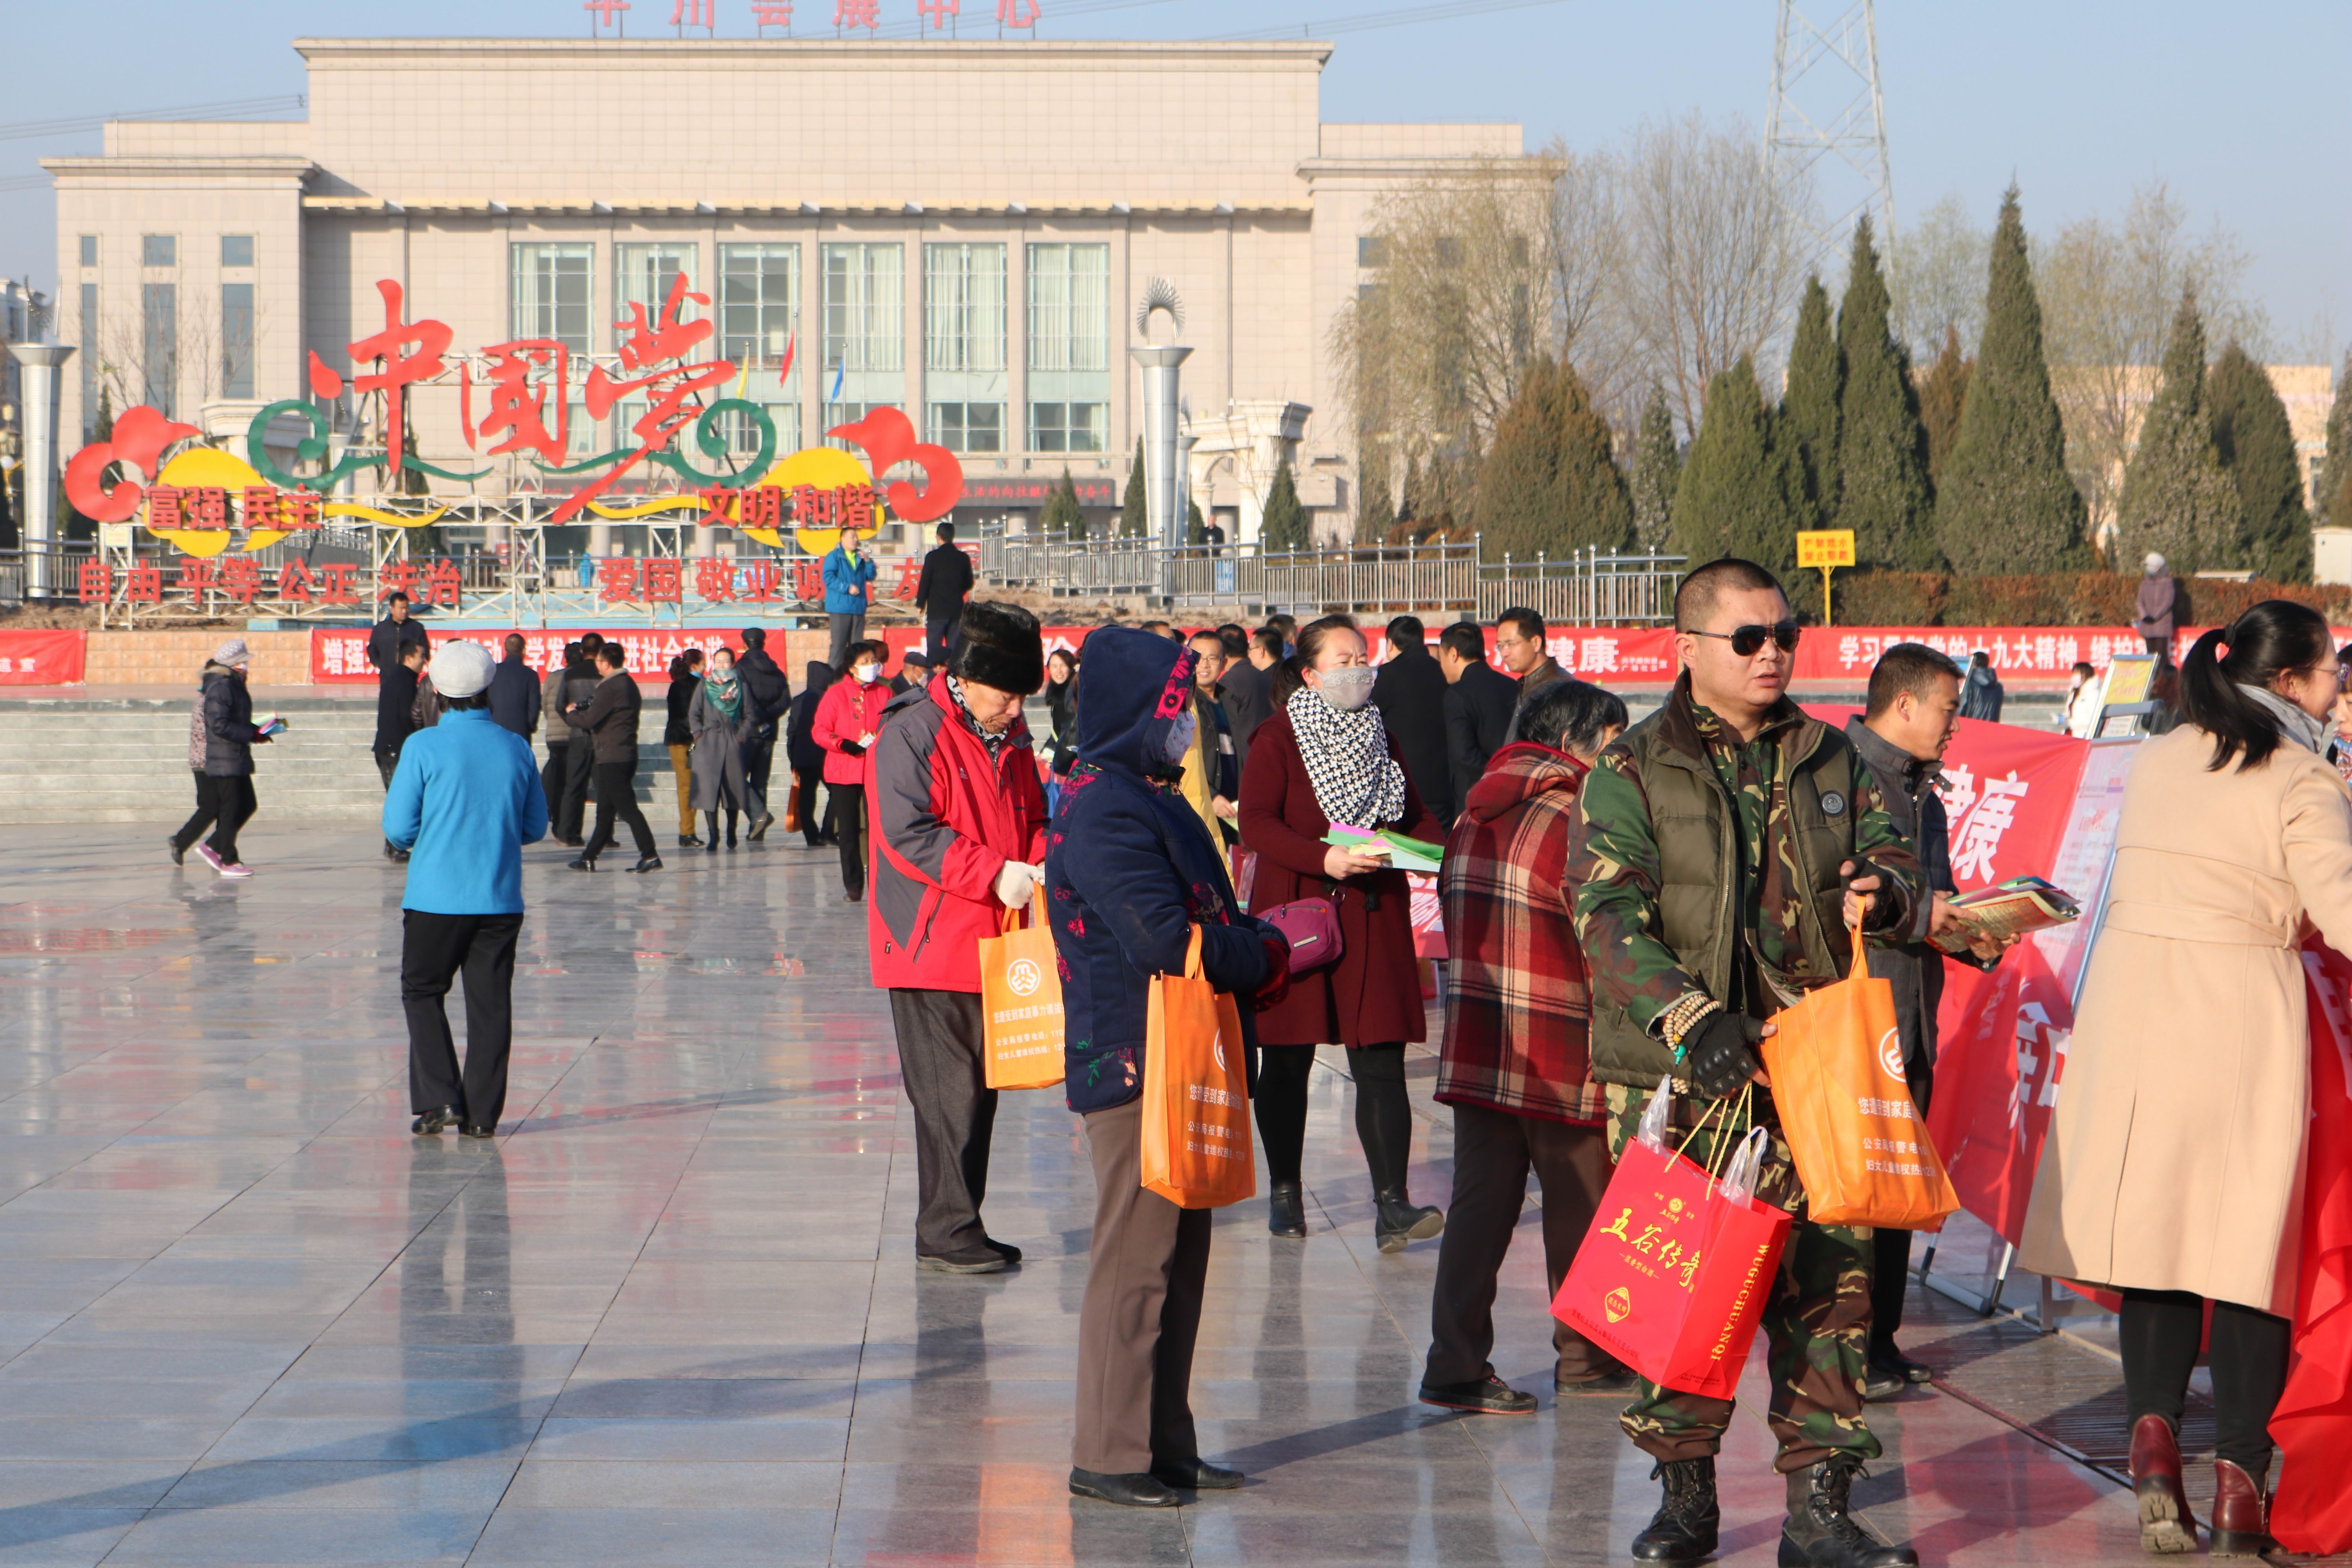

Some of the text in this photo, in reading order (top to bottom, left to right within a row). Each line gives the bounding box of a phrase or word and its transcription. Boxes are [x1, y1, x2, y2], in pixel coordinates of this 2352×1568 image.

[145, 483, 323, 530] 富强 民主
[698, 482, 877, 529] 文明 和谐
[80, 557, 462, 605] 自由 平等 公正 法治
[598, 557, 682, 604] 爱国
[696, 557, 783, 603] 敬业
[1051, 1029, 1064, 1038] 110
[1600, 1207, 1700, 1287] 五谷传奇
[1710, 1244, 1770, 1361] WUGUCHUANQI
